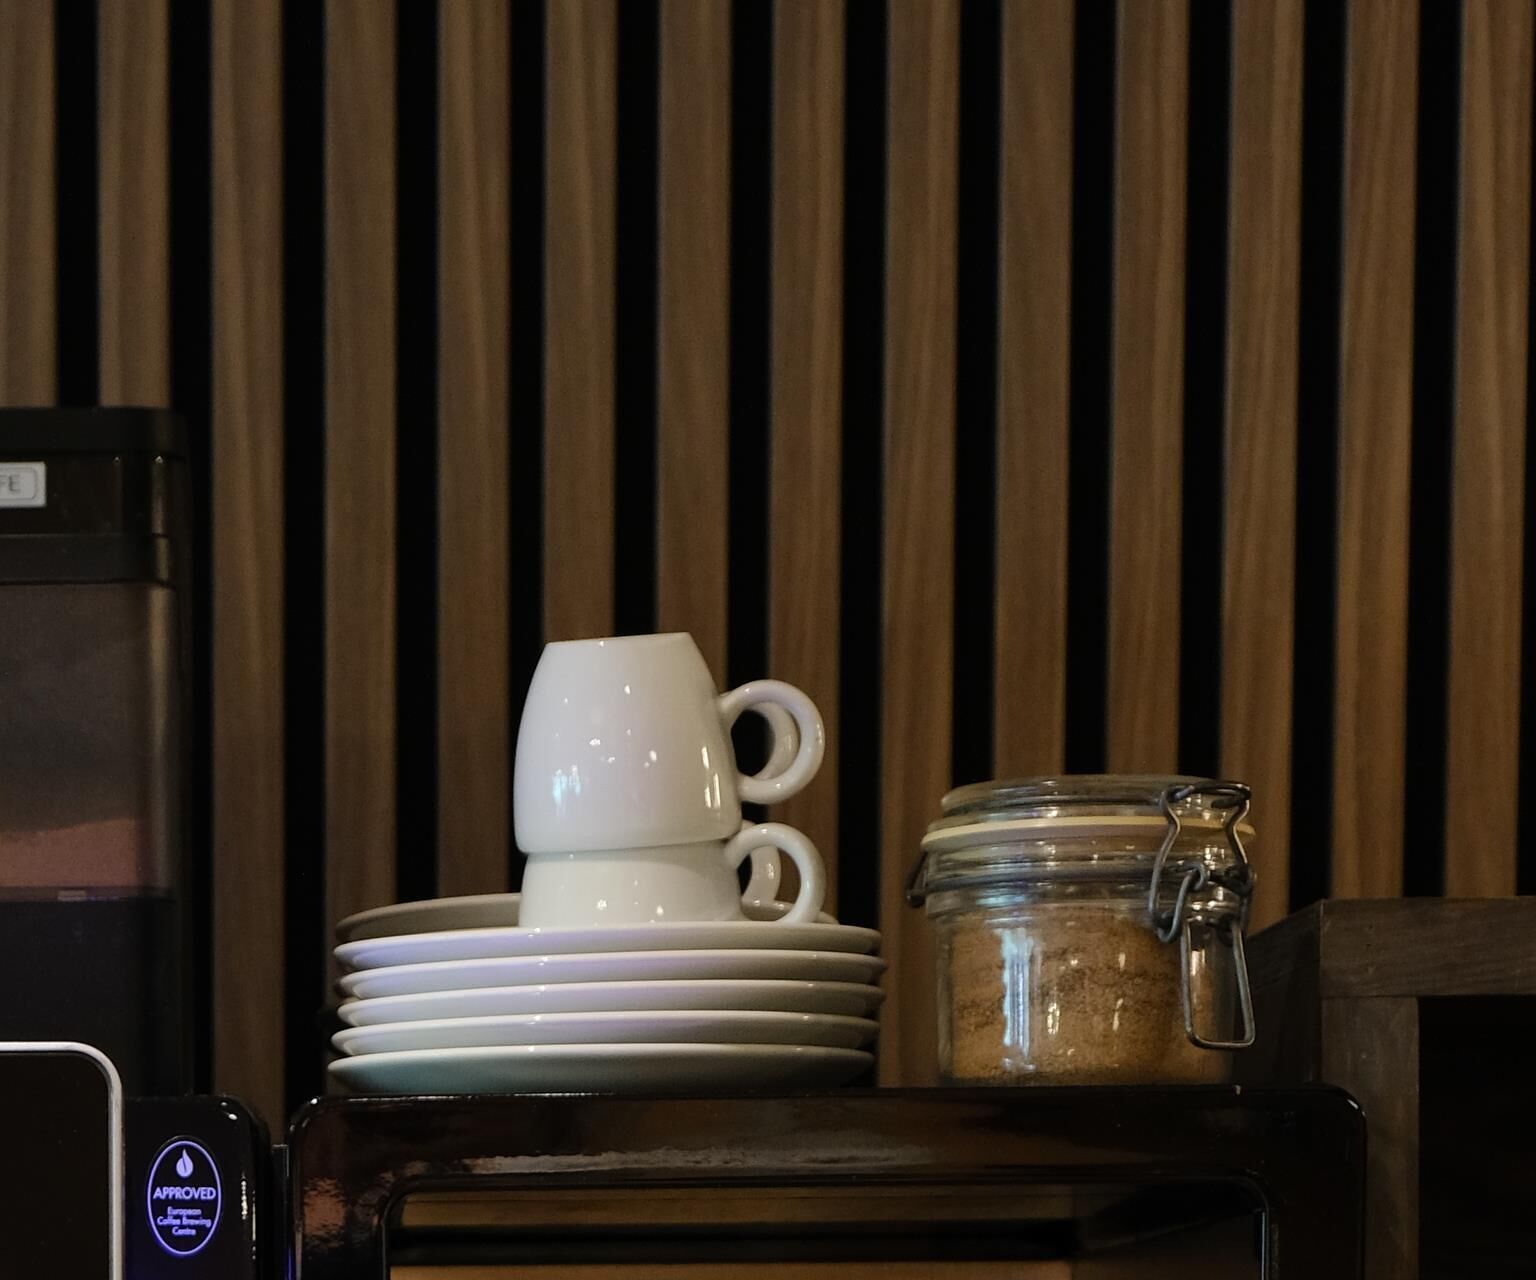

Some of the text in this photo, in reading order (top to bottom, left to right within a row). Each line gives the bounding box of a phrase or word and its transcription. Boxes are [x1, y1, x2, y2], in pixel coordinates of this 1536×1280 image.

[153, 1187, 216, 1200] APPROVED
[167, 1206, 202, 1216] European
[157, 1216, 212, 1228] Coffee Brewing
